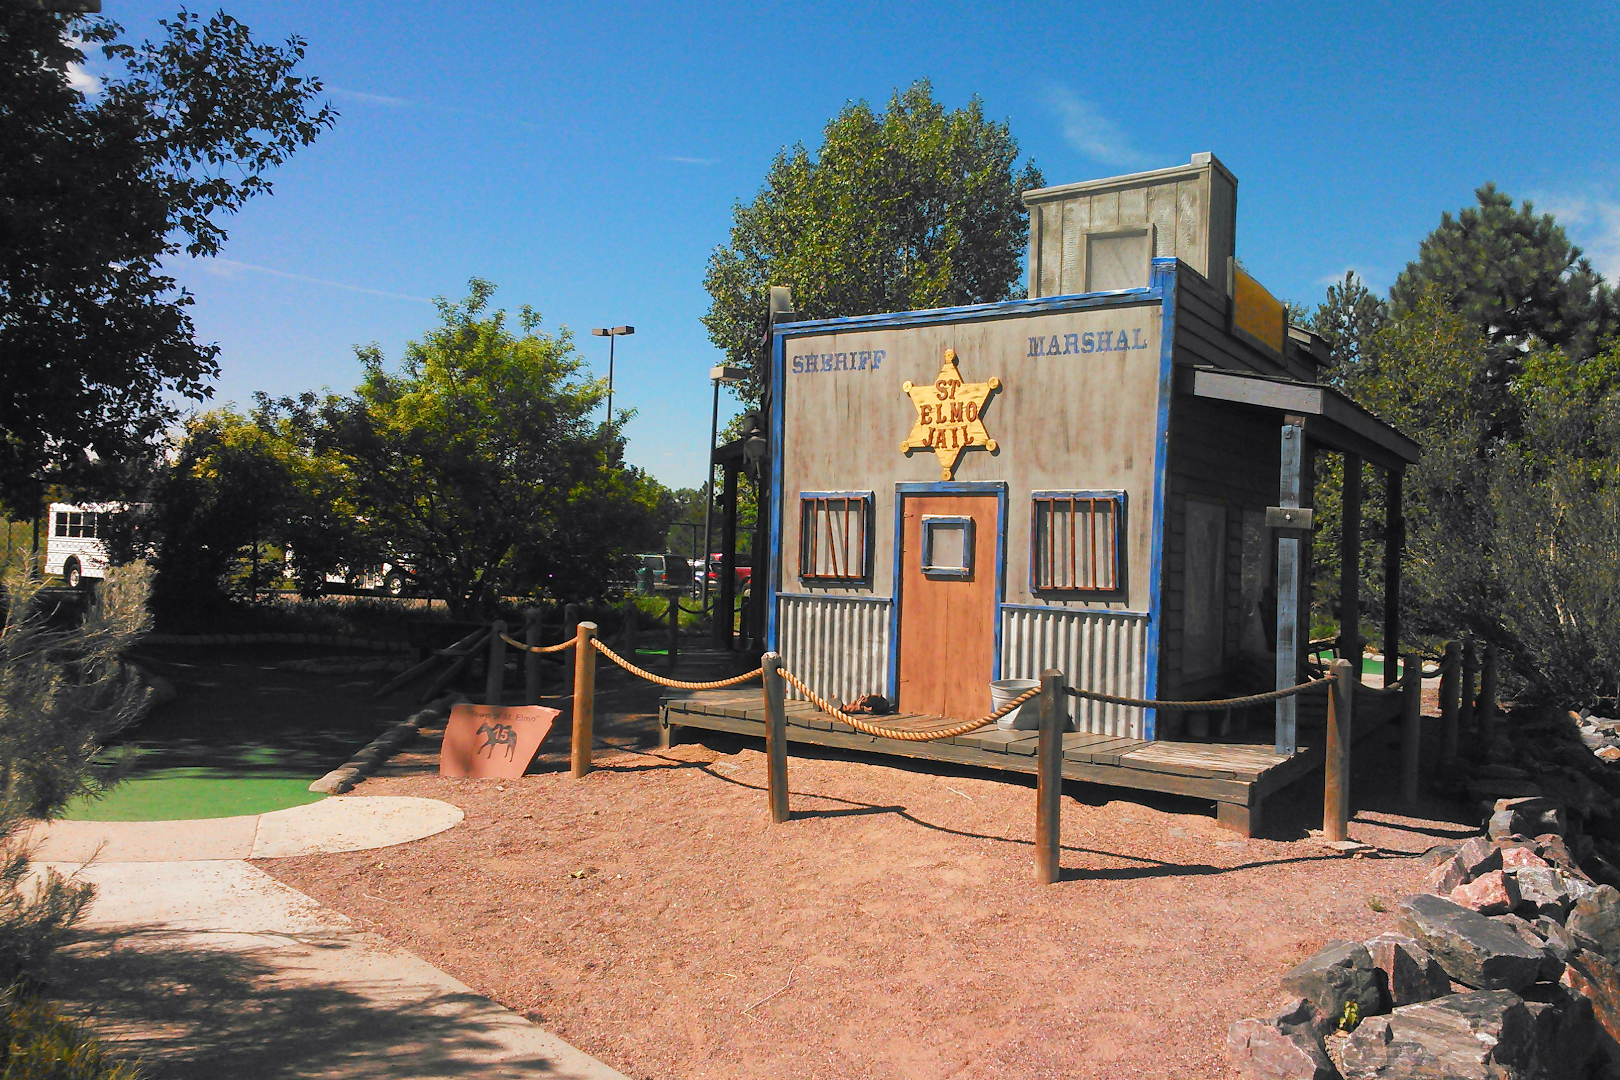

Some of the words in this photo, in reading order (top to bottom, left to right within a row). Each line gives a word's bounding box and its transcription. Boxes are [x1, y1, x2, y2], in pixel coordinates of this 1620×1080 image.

[1027, 328, 1148, 357] MARSHAL
[792, 350, 886, 374] SHERIFF
[936, 379, 961, 401] ST
[920, 401, 978, 425] ELMO
[922, 425, 974, 449] JAIL
[493, 728, 510, 741] 15
